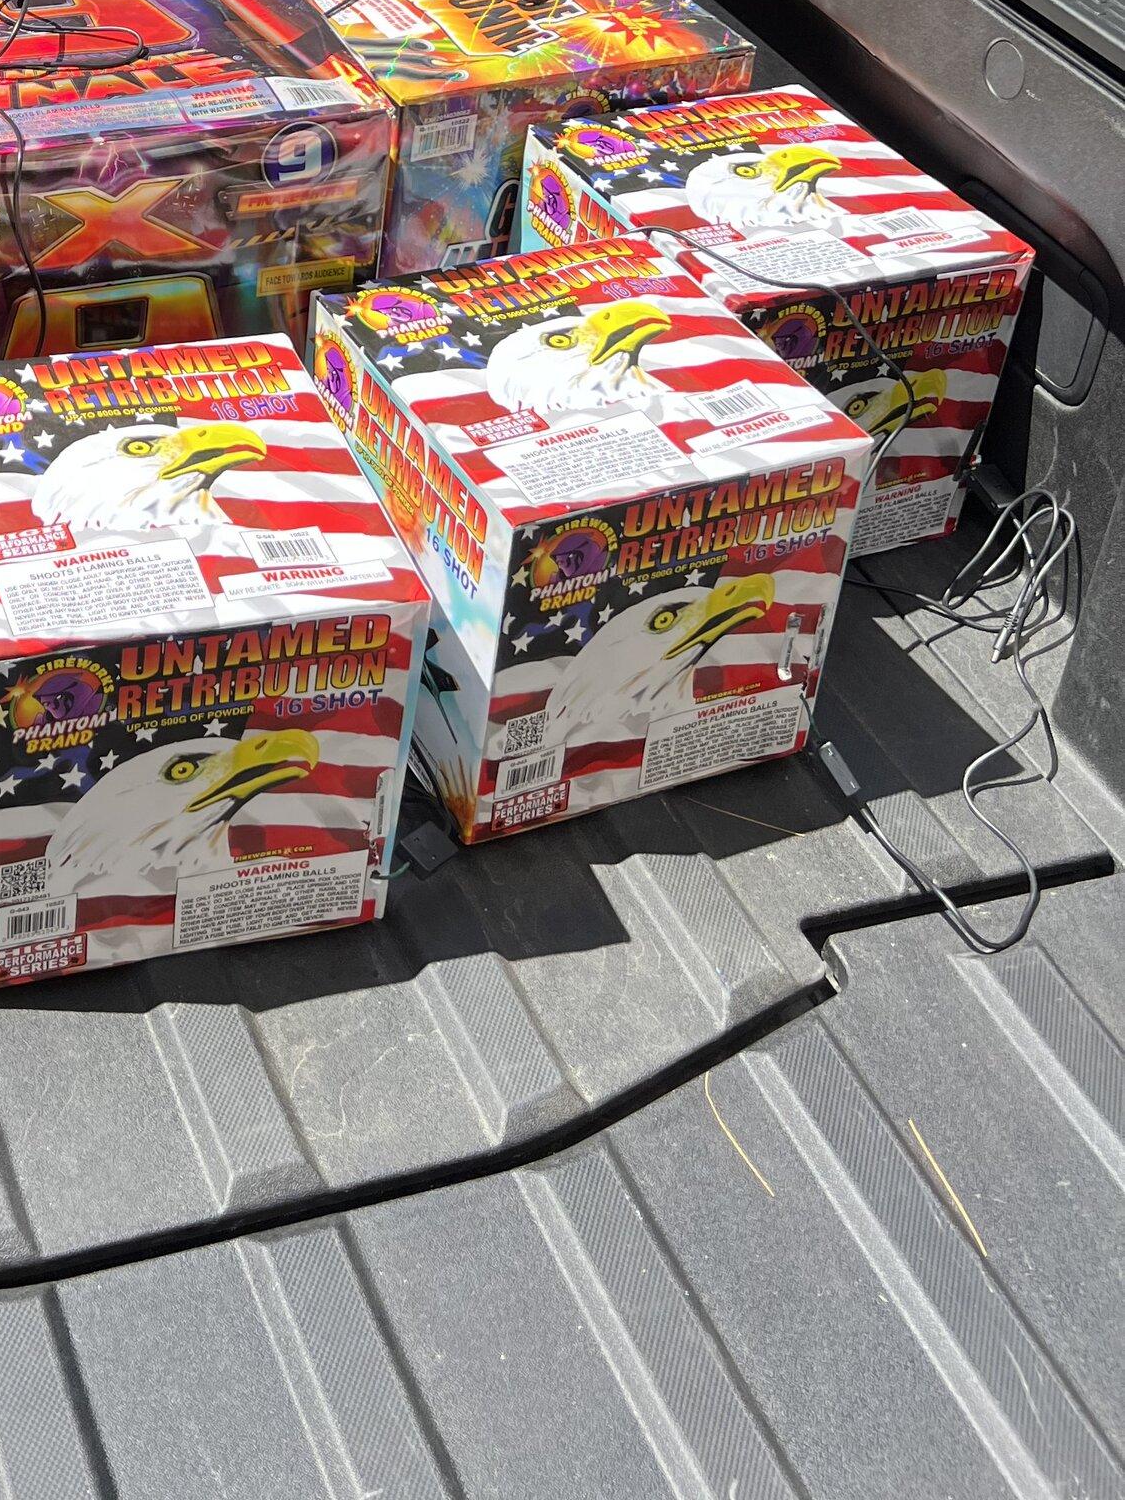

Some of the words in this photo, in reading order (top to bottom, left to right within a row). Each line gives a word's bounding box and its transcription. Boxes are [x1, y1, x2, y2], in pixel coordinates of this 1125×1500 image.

[191, 84, 256, 99] WARNING
[190, 108, 209, 116] WITH
[211, 104, 234, 113] WATER
[236, 101, 257, 109] AFTER
[625, 93, 803, 132] UNTAMED
[645, 109, 827, 150] RETRIBUTION
[278, 130, 323, 182] 9
[586, 149, 652, 165] PHANTOM
[602, 156, 649, 171] BRAND
[32, 179, 202, 268] X
[527, 203, 572, 244] PHANTOM
[531, 218, 563, 248] BRAND
[739, 237, 790, 251] WARNING
[896, 232, 953, 249] WARNING
[266, 276, 281, 285] FACE
[314, 266, 345, 278] AUDIENCE
[429, 238, 633, 294] UNTAMED
[357, 285, 437, 305] FIREWORKS
[451, 257, 662, 318] RETRIBUTION
[601, 281, 626, 300] 16
[626, 276, 679, 298] SHOT
[832, 269, 1017, 327] UNTAMED
[541, 295, 581, 314] POWDER
[375, 314, 452, 338] PHANTOM
[777, 303, 827, 338] FIREWORKS
[826, 302, 1006, 360] RETRIBUTION
[395, 324, 449, 344] BRAND
[948, 332, 997, 353] SHOT
[32, 341, 273, 389] UNTAMED
[43, 365, 291, 414] RETRIBUTION
[314, 374, 355, 431] PHANTOM
[123, 407, 138, 417] OF
[138, 404, 182, 416] POWDER
[210, 402, 236, 420] 16
[242, 394, 299, 417] SHOT
[468, 409, 539, 430] HIGH
[470, 415, 537, 436] PERFORMANCE
[487, 425, 534, 443] SERIES
[536, 426, 600, 447] WARNING
[721, 413, 790, 438] WARNING
[361, 369, 489, 544] UNTAMED
[520, 445, 558, 460] SHOOTS
[559, 437, 598, 452] FLAMING
[599, 428, 629, 442] BALLS
[355, 404, 486, 584] RETRIBUTION
[623, 457, 846, 538] UNTAMED
[875, 484, 923, 504] WARNING
[913, 490, 937, 502] BALLS
[555, 517, 619, 551] FIREWORKS
[617, 489, 842, 576] RETRIBUTION
[2, 541, 57, 557] SERIES
[53, 549, 130, 569] WARNING
[744, 544, 766, 564] 16
[773, 528, 832, 557] SHOT
[29, 568, 73, 581] SHOOTS
[77, 560, 124, 574] FLAMING
[126, 554, 162, 567] BALLS
[262, 566, 345, 583] WARNING
[426, 528, 439, 551] 16
[444, 549, 478, 599] SHOT
[674, 565, 688, 577] OF
[688, 554, 729, 572] POWDER
[229, 588, 244, 596] MAY
[285, 580, 305, 588] SOAK
[306, 579, 324, 587] WITH
[325, 576, 349, 585] WATER
[349, 573, 372, 581] AFTER
[530, 570, 609, 602] PHANTOM
[540, 586, 595, 612] BRAND
[118, 614, 391, 681] UNTAMED
[35, 656, 115, 695] FIREWORKS
[117, 647, 387, 722] RETRIBUTION
[275, 699, 301, 717] 16
[311, 688, 384, 711] SHOT
[697, 696, 757, 719] WARNING
[12, 713, 109, 746] PHANTOM
[125, 722, 141, 733] UP
[144, 719, 158, 731] TO
[190, 712, 205, 724] OF
[206, 705, 255, 720] POWDER
[673, 719, 708, 734] SHOOTS
[709, 707, 749, 725] FLAMING
[750, 700, 778, 713] BALLS
[25, 731, 94, 755] BRAND
[495, 782, 566, 810] HIGH
[495, 791, 566, 819] PERFORMANCE
[504, 804, 553, 826] SERIES
[235, 849, 283, 863] FIREWORKS
[237, 860, 310, 878] WARNING
[209, 878, 251, 892] SHOOTS
[254, 871, 300, 885] FLAMING
[303, 866, 337, 877] BALLS
[10, 956, 69, 977] SERIES
